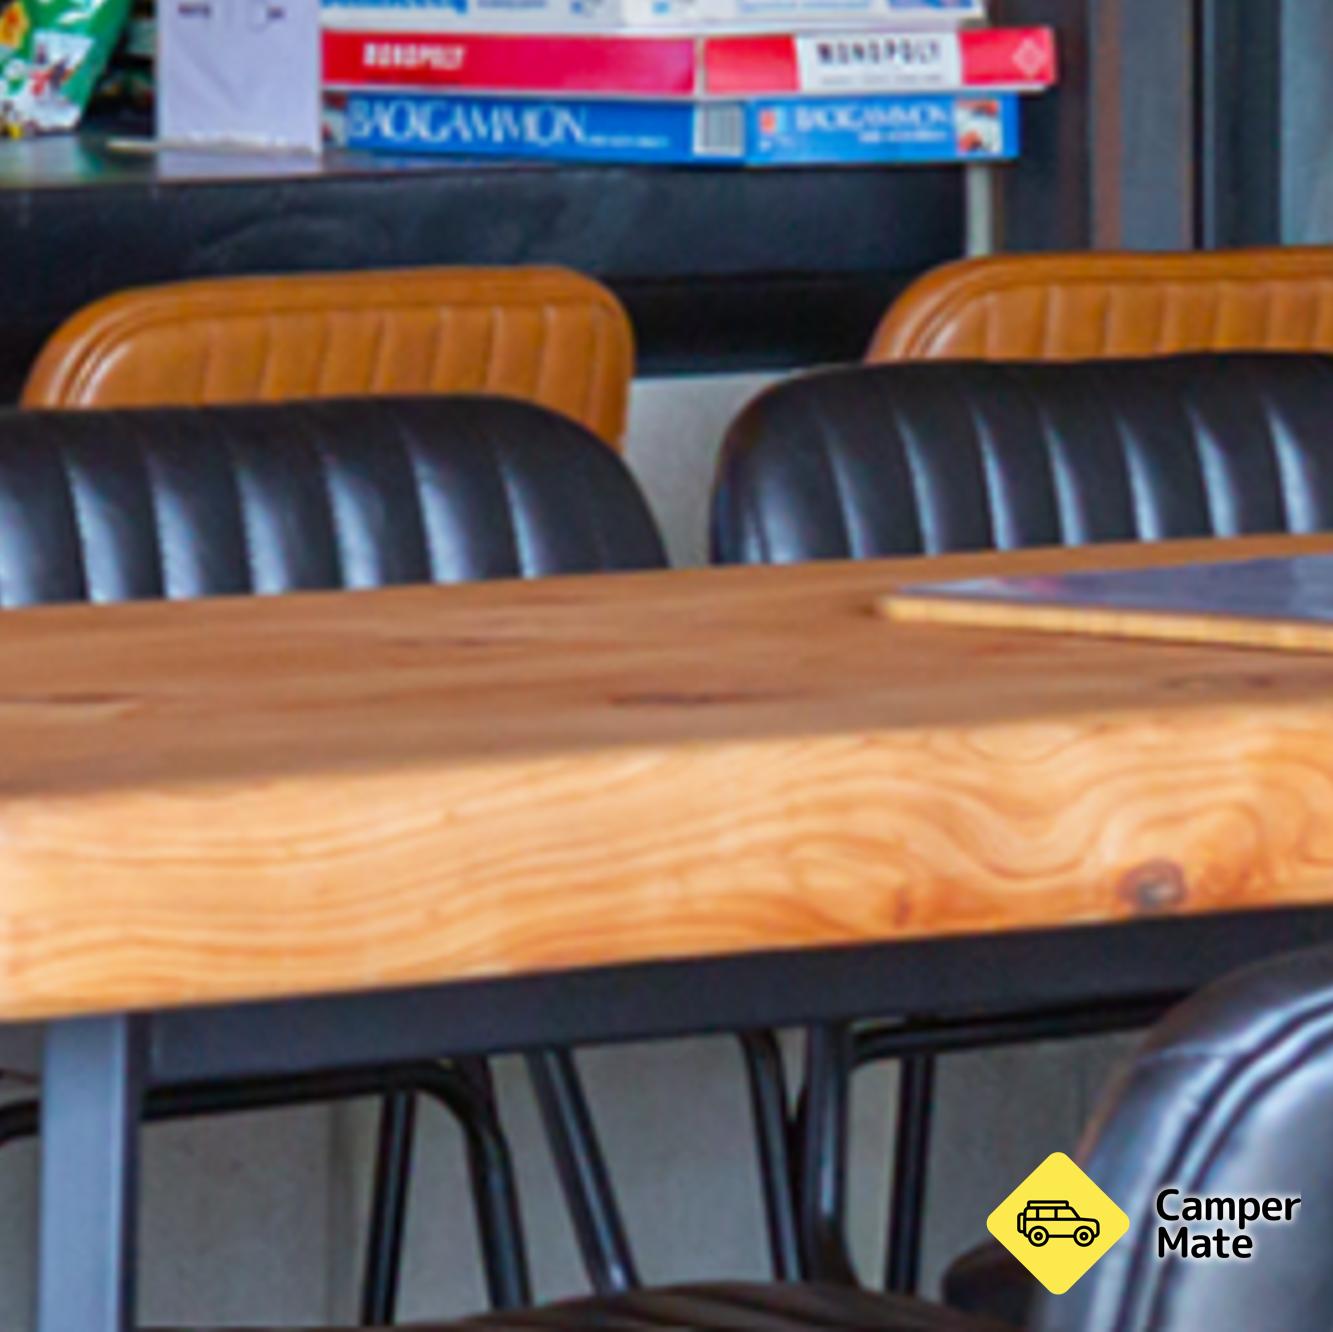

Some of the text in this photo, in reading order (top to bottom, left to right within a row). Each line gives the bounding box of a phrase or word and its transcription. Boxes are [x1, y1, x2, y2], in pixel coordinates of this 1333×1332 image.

[362, 42, 465, 70] MONOPOLY
[816, 38, 941, 65] MONOPOLY
[345, 97, 585, 146] BACKGAMMON
[795, 102, 950, 131] BACKGAMMON
